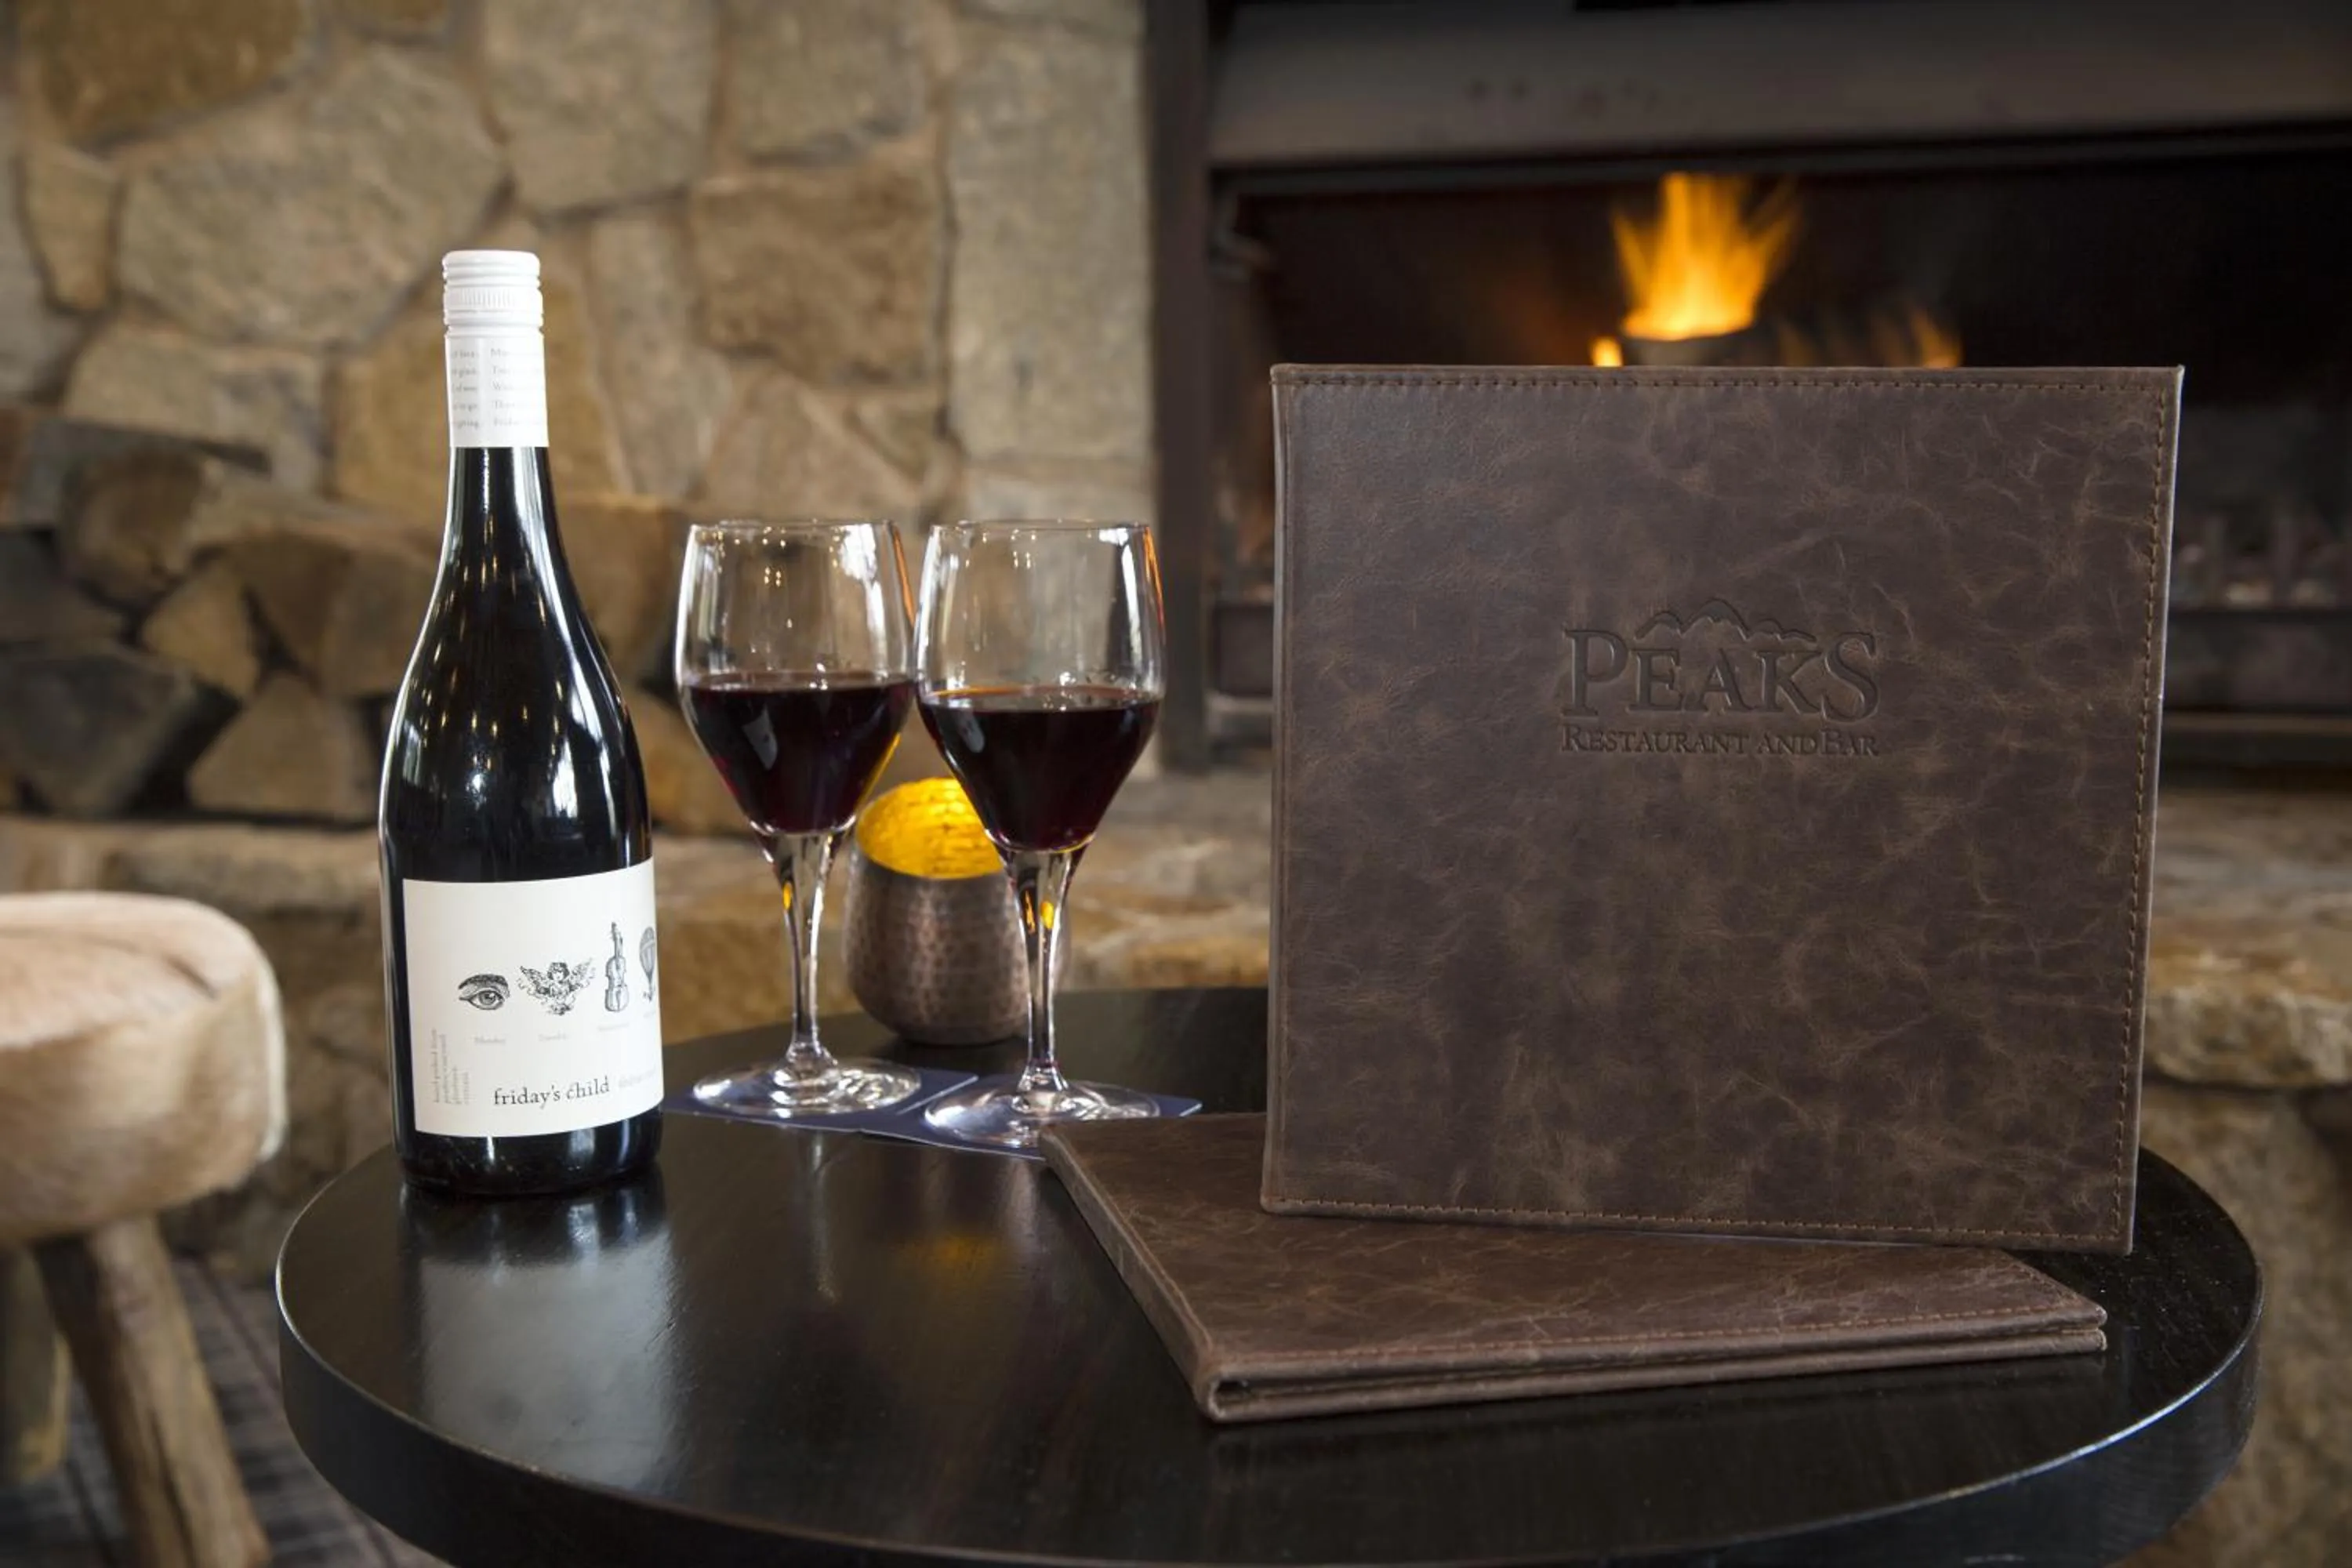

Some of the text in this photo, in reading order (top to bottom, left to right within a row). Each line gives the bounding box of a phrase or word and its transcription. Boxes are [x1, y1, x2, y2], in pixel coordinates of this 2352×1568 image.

[1563, 629, 1879, 722] PEAKS
[493, 1083, 561, 1110] friday's
[567, 1075, 610, 1100] child
